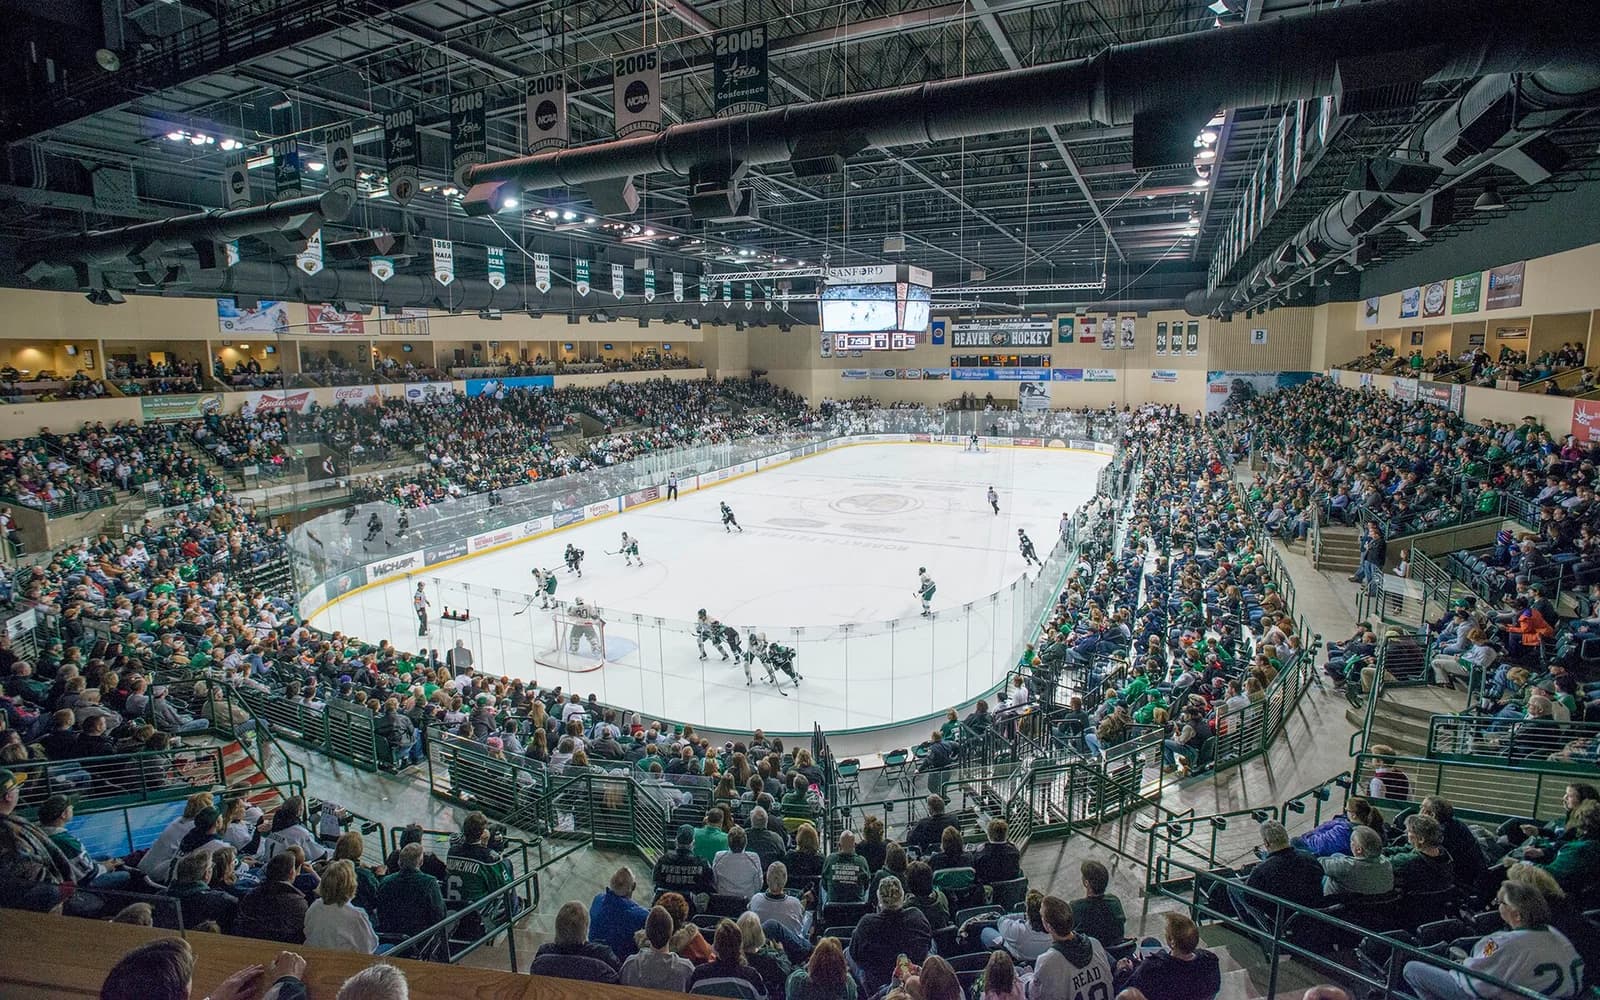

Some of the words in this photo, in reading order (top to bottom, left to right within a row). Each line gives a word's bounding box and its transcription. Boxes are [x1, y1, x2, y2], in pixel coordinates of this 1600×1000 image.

[716, 27, 764, 56] 2005
[615, 52, 657, 77] 2005
[527, 74, 563, 96] 2006
[717, 86, 765, 100] Conference
[451, 92, 483, 113] 2008
[626, 94, 649, 107] NCAA
[385, 109, 414, 130] 2009
[537, 113, 558, 125] NCAA
[326, 125, 351, 144] 2009
[274, 140, 297, 157] 2010
[954, 331, 990, 345] BEAVER
[1011, 330, 1050, 345] HOCKEY
[1255, 330, 1264, 340] B
[1072, 966, 1102, 991] READ
